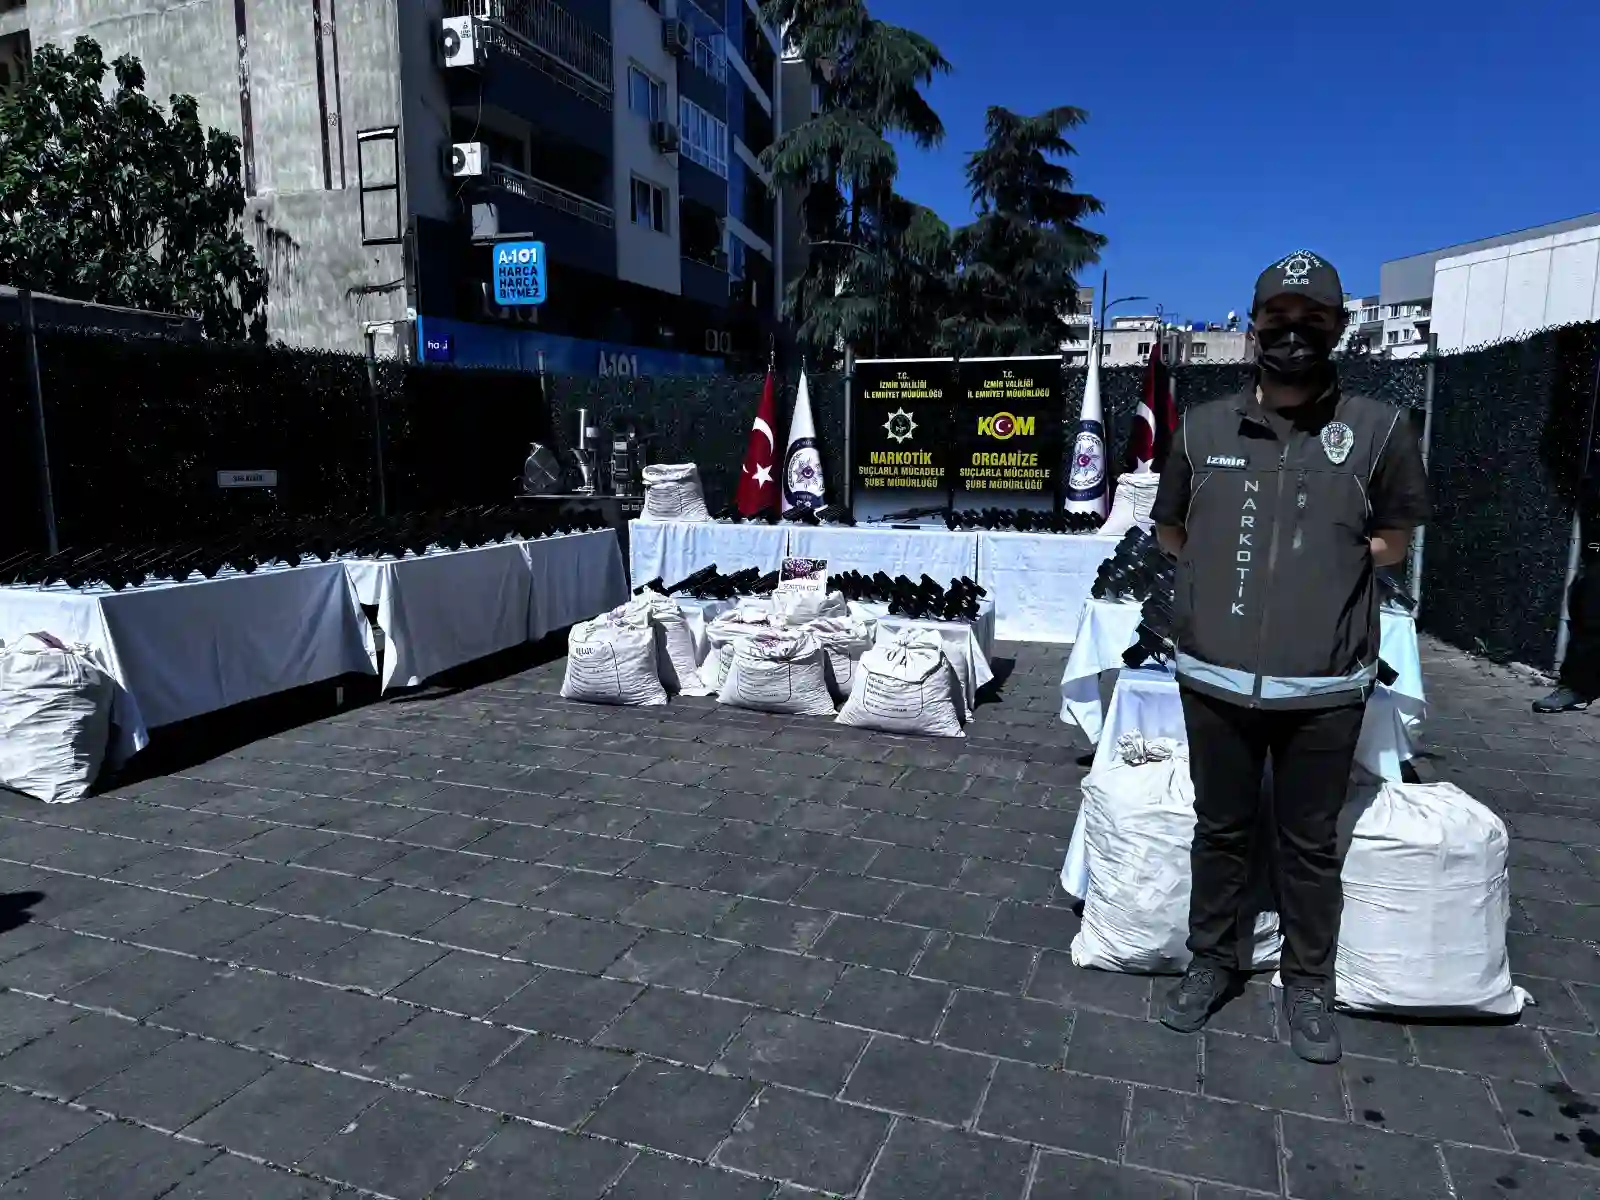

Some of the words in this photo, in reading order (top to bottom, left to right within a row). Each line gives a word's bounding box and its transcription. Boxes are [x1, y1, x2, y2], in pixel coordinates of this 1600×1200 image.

[499, 266, 537, 277] HARCA
[499, 277, 538, 288] HARCA
[1002, 370, 1014, 378] T.C.
[978, 412, 1035, 440] KOM
[870, 448, 932, 464] NARKOTİK
[972, 450, 1038, 466] ORGANİZE
[960, 468, 1001, 478] SUÇLARLA
[1004, 467, 1050, 478] MÜCADELE
[865, 478, 885, 488] ŞUBE
[965, 480, 987, 490] ŞUBE
[989, 479, 1042, 490] MÜDÜRLÜĞÜ
[1231, 480, 1259, 616] NARKOTİK
